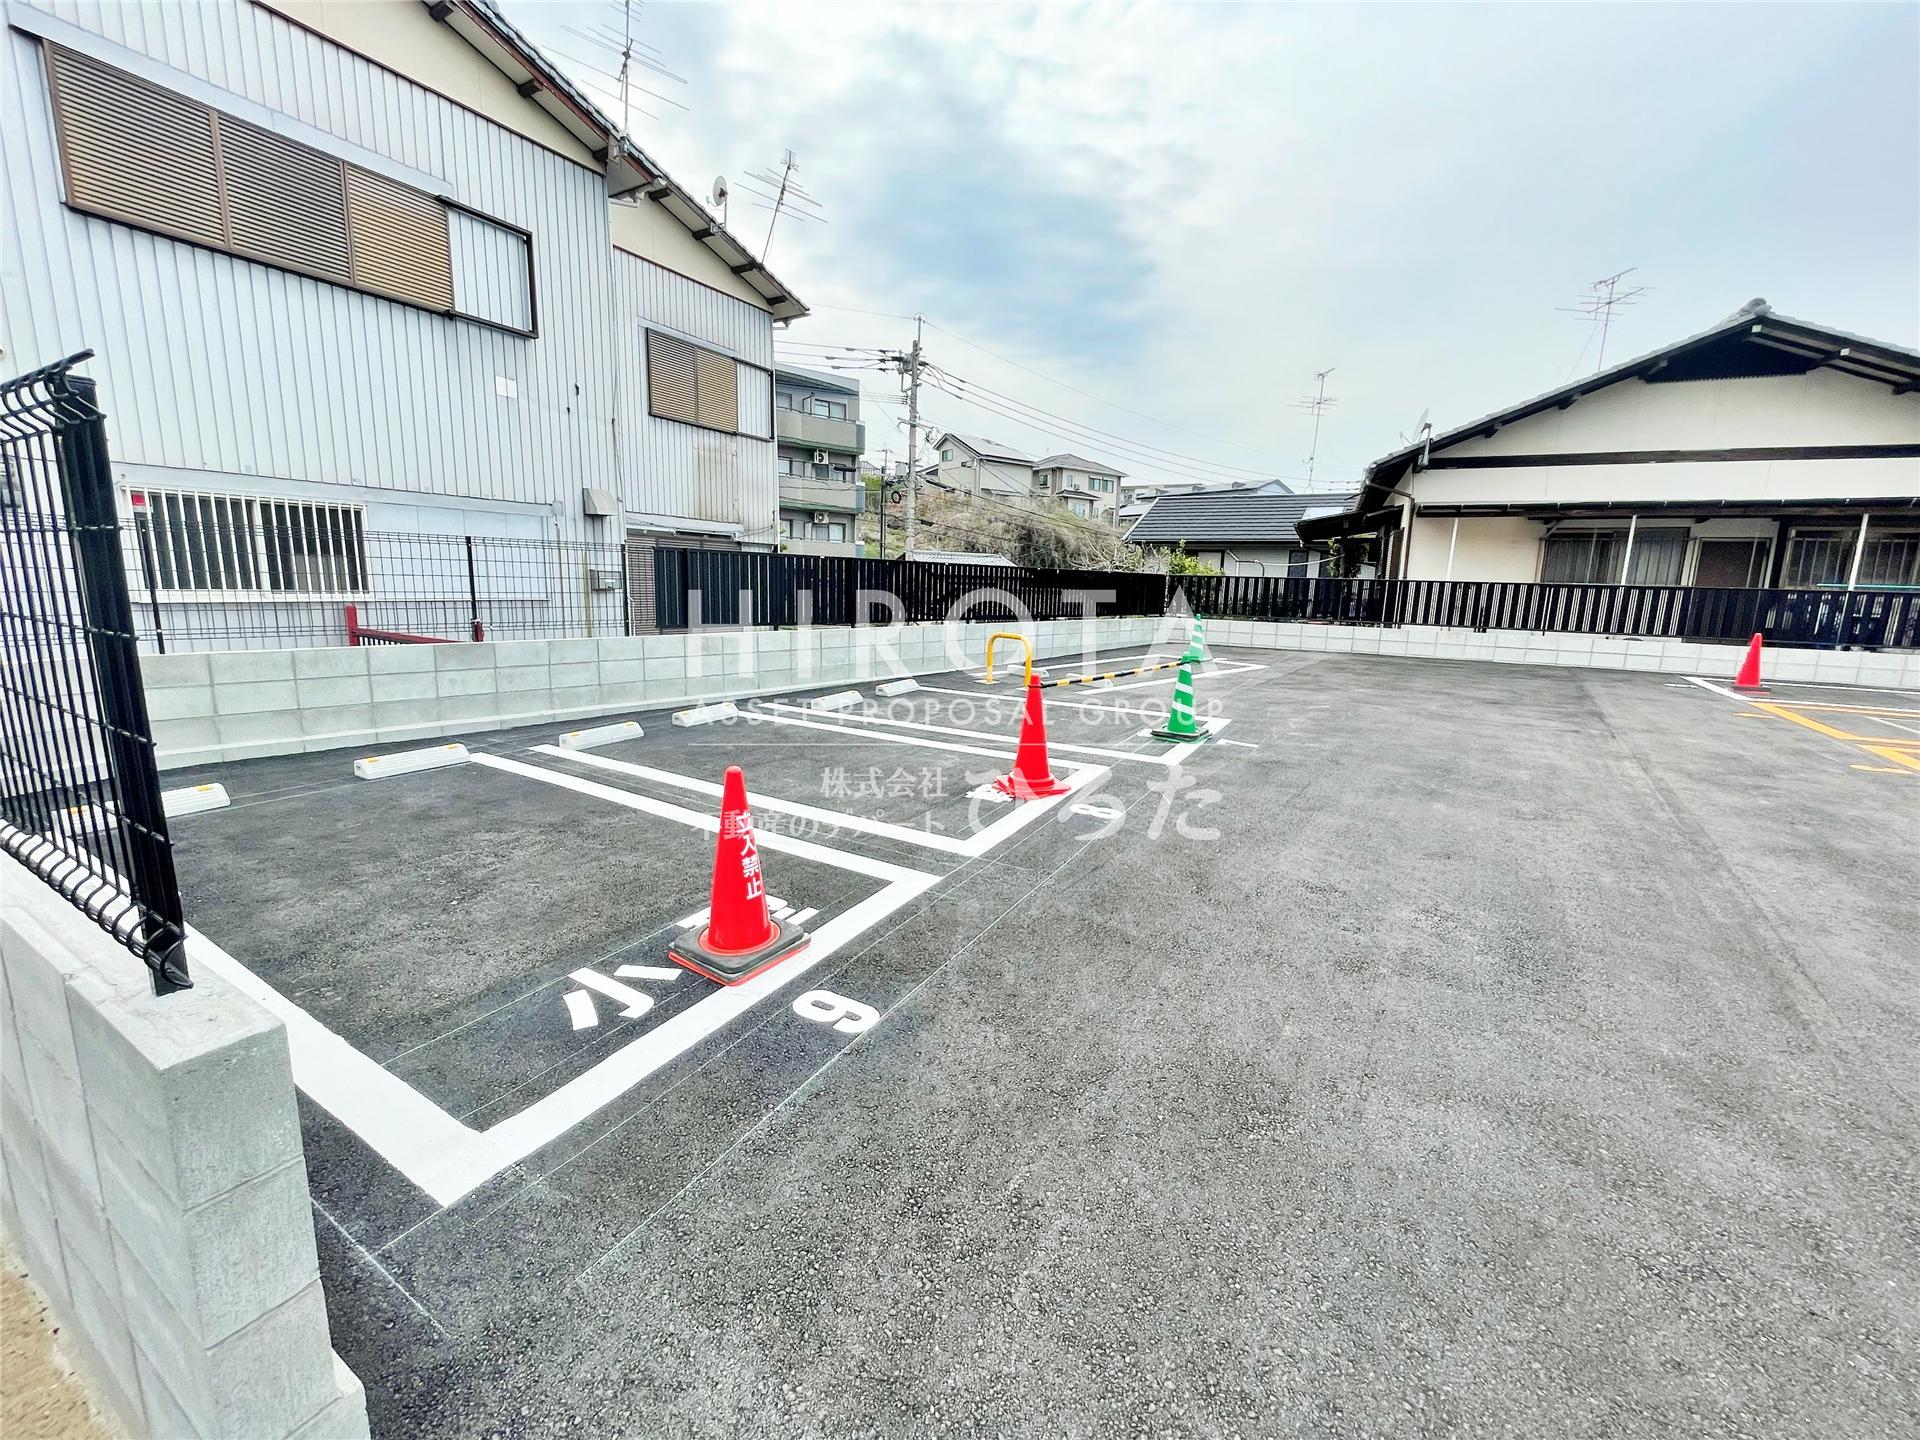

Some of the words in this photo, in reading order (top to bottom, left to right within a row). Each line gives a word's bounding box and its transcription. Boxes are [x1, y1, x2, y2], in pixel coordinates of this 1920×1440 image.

[735, 811, 763, 900] 立入禁止
[793, 989, 881, 1033] 9
